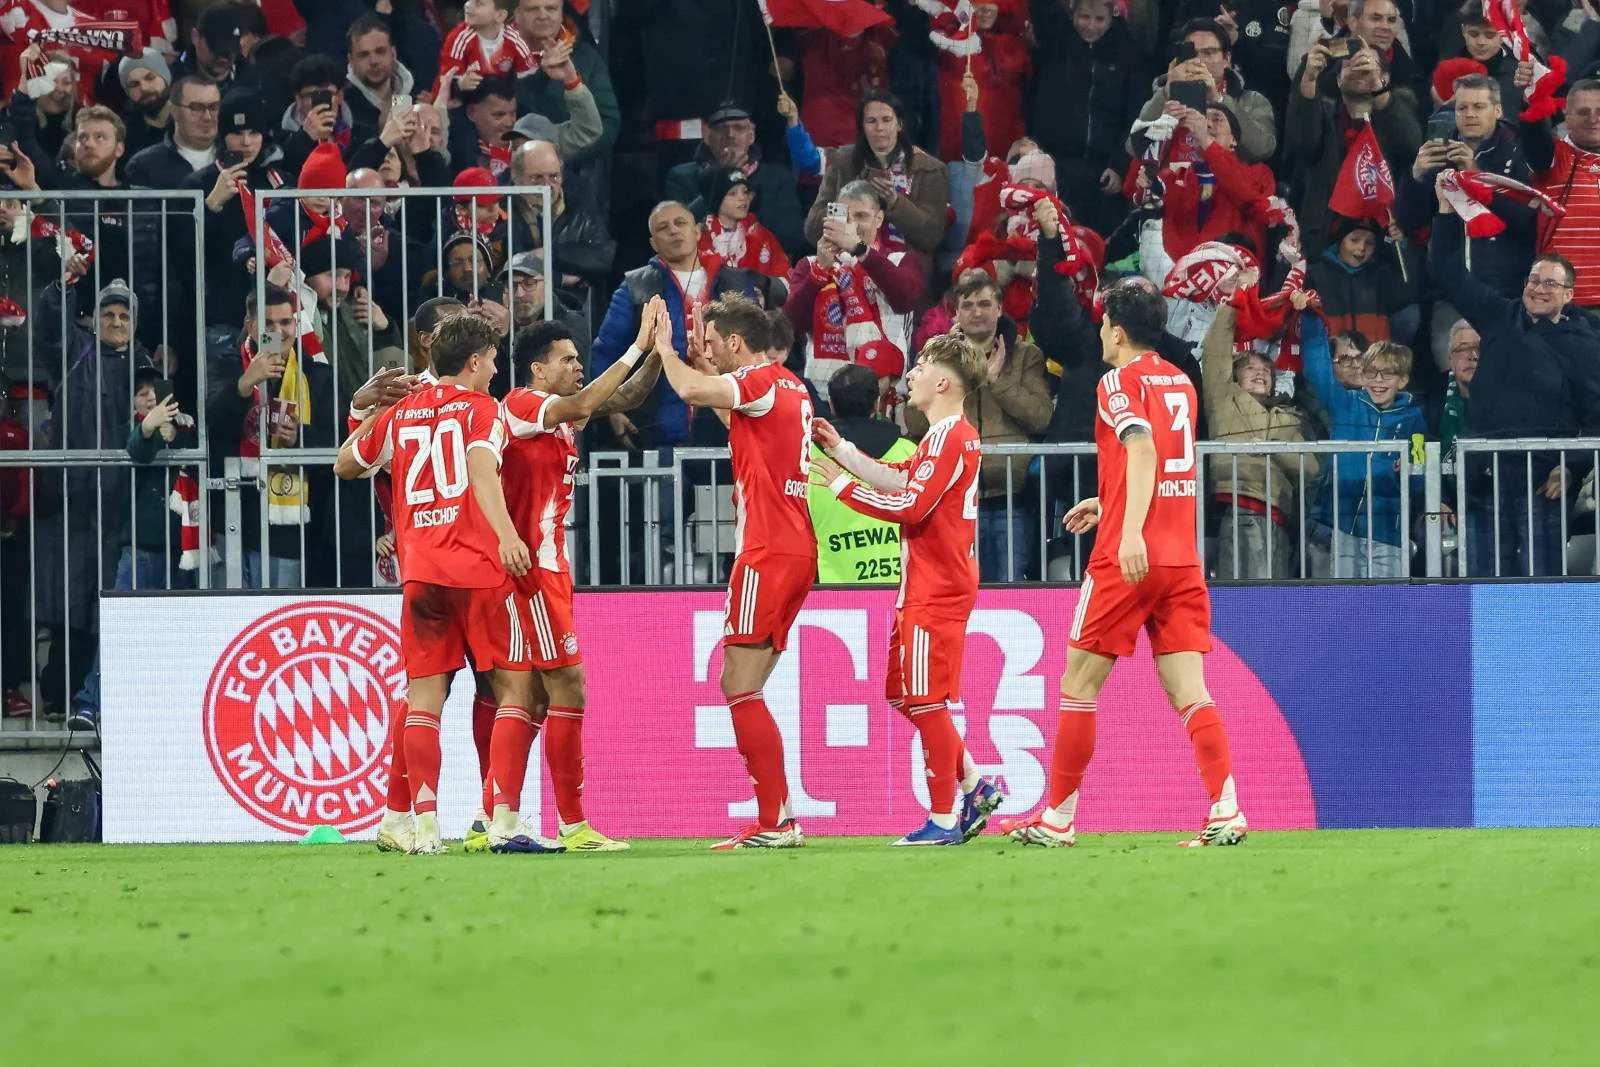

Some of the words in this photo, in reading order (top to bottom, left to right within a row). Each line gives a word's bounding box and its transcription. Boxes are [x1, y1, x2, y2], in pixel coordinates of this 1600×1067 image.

[404, 407, 435, 419] BAYERN
[1162, 391, 1195, 473] 3
[398, 417, 470, 506] 20
[413, 506, 461, 529] BISCHOF
[828, 526, 899, 553] STEWA
[855, 556, 901, 581] 2253
[223, 651, 269, 704] FC
[226, 742, 393, 822] MÜNCHE
